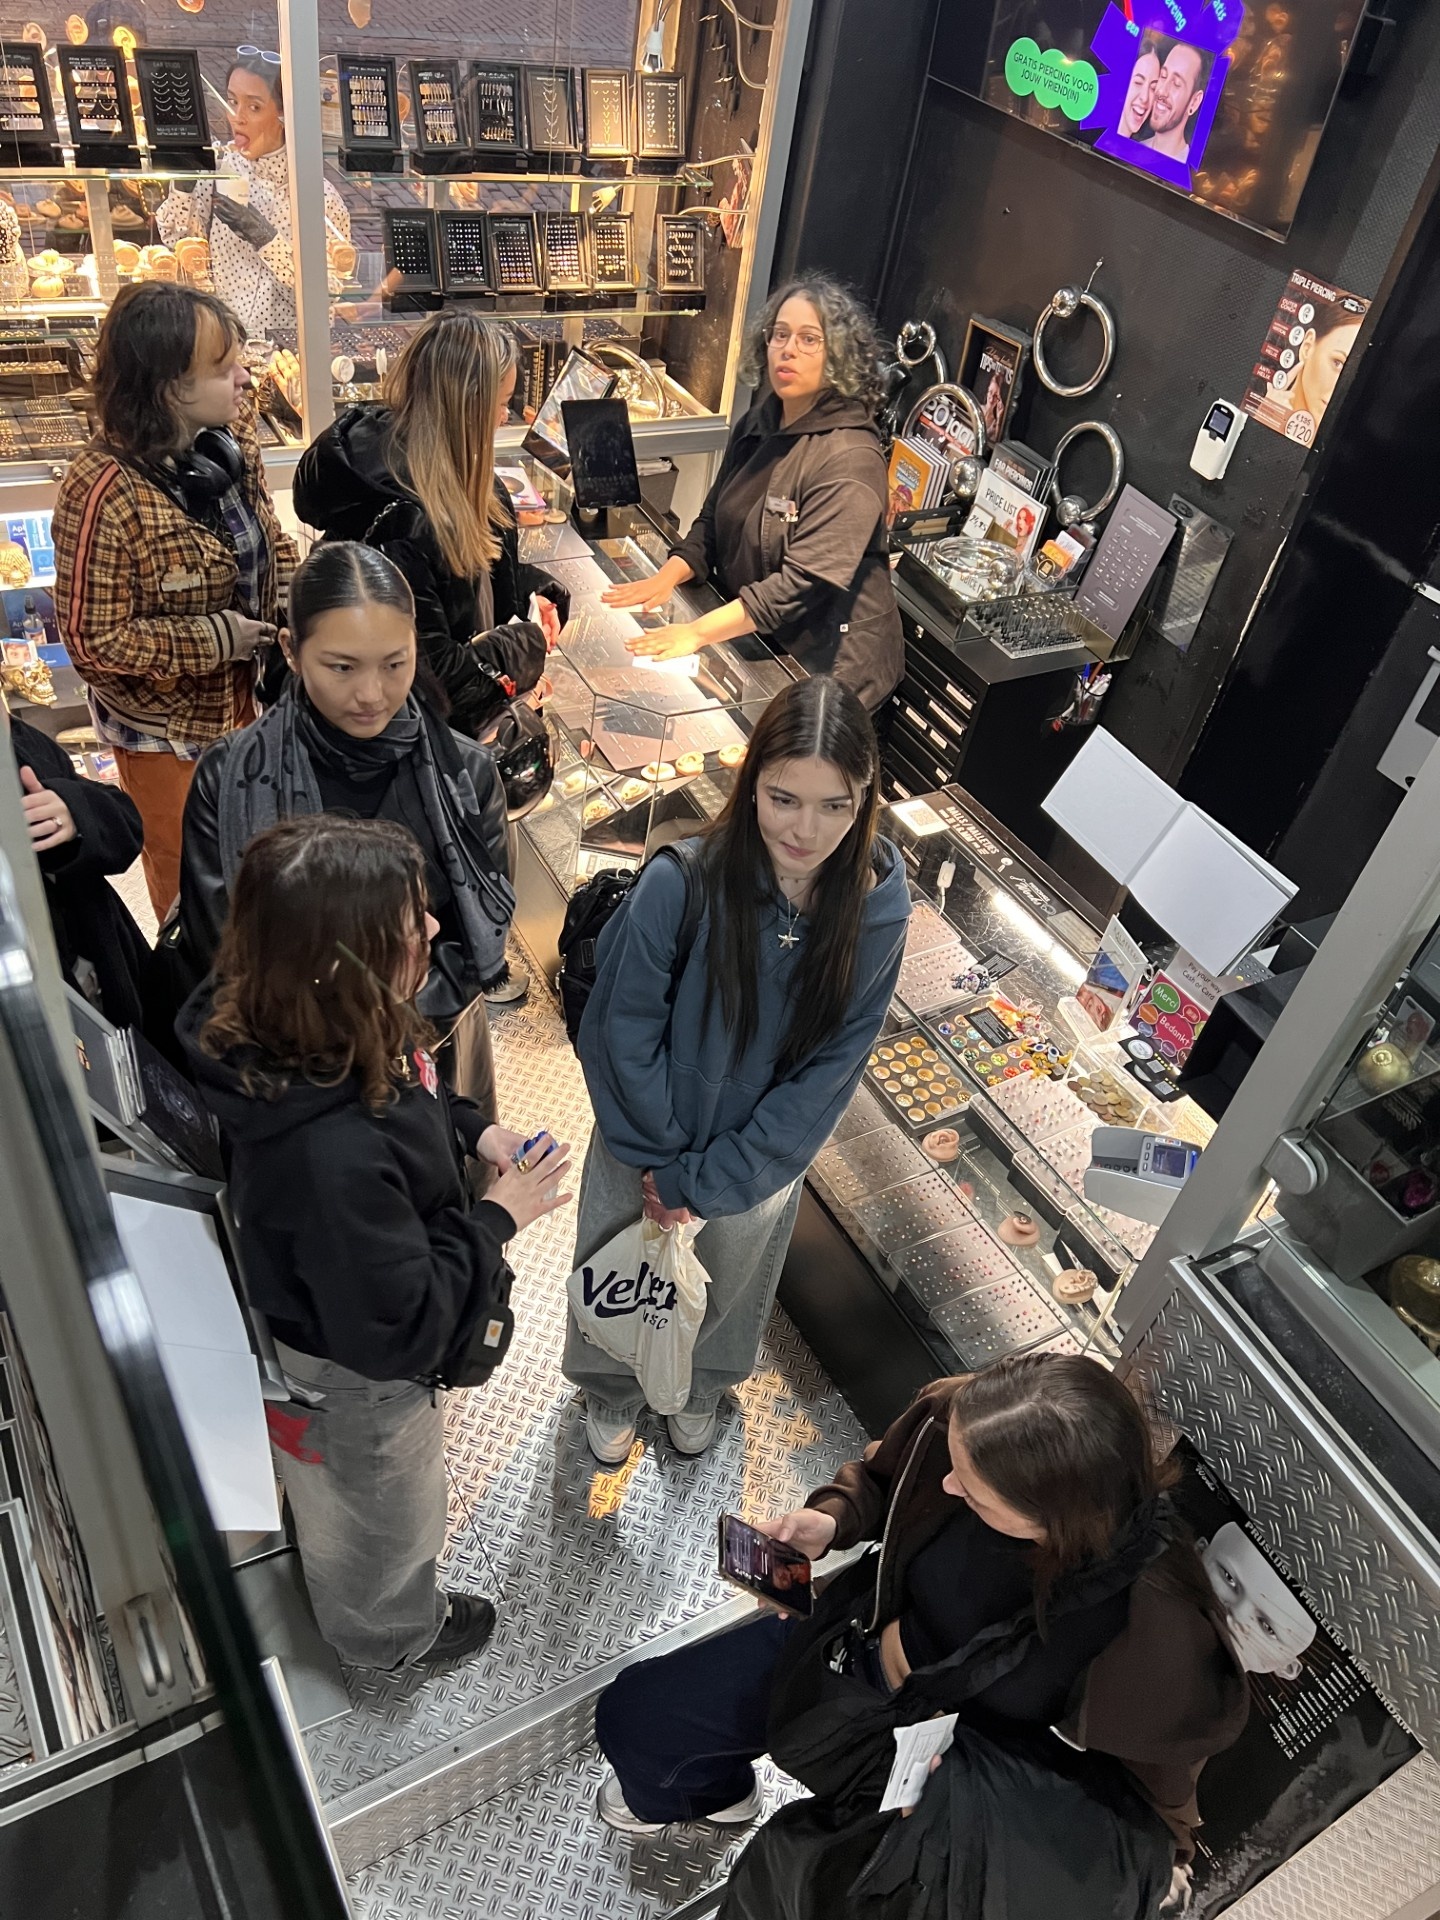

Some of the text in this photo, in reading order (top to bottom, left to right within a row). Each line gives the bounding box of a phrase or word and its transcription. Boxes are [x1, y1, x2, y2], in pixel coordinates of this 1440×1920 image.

[1164, 0, 1186, 32] ercing
[1212, 0, 1226, 22] atis
[1014, 52, 1094, 95] GRATIS PIERCING VOOR
[1020, 68, 1080, 104] JOUW VRIEND(IN)
[1290, 272, 1337, 302] TRIPLE PIERCING
[1286, 420, 1312, 442] €120
[985, 488, 1018, 518] PRICE LIST
[1182, 970, 1195, 983] Cash
[1202, 986, 1215, 1000] Card
[1188, 962, 1222, 994] Pay your way
[1156, 986, 1177, 1008] Merci
[1160, 1016, 1190, 1046] Bedankt
[1245, 1522, 1294, 1581] PRIJSLIJST
[1300, 1588, 1348, 1652] PRICELIST
[1348, 1654, 1414, 1735] AMSTERDAM
